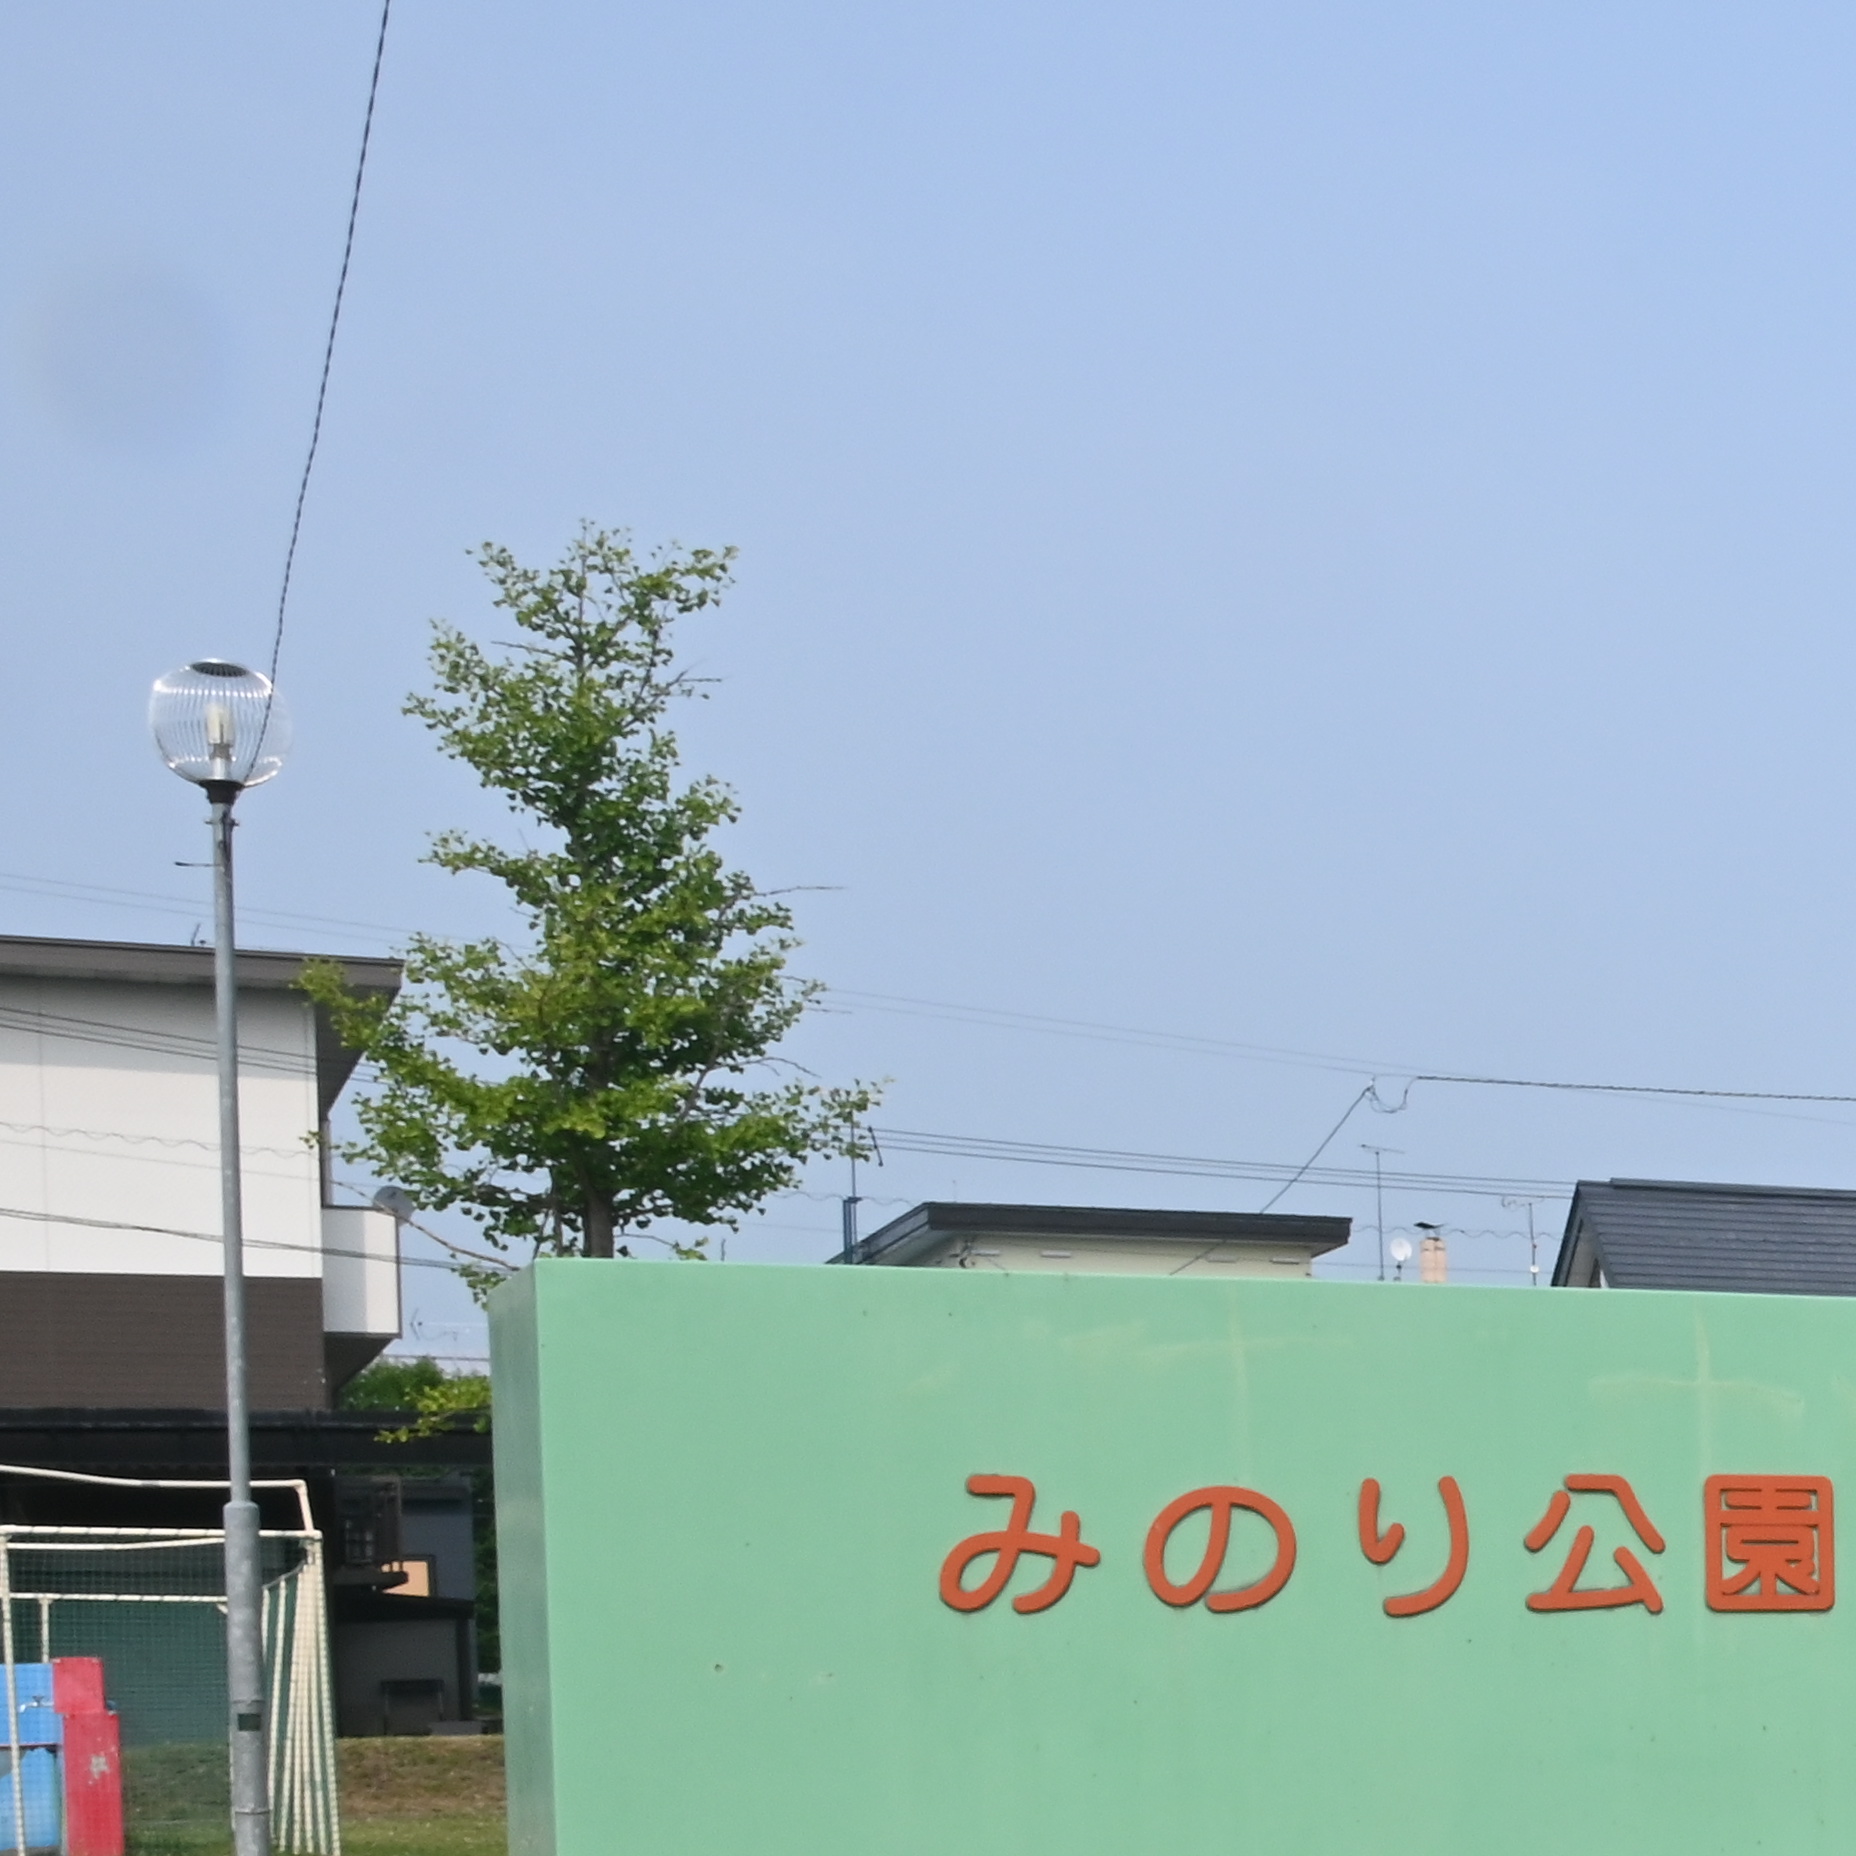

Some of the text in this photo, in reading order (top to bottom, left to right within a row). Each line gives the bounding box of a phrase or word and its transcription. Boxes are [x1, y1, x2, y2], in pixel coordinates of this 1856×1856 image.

[939, 1473, 1835, 1617] みのり公園
